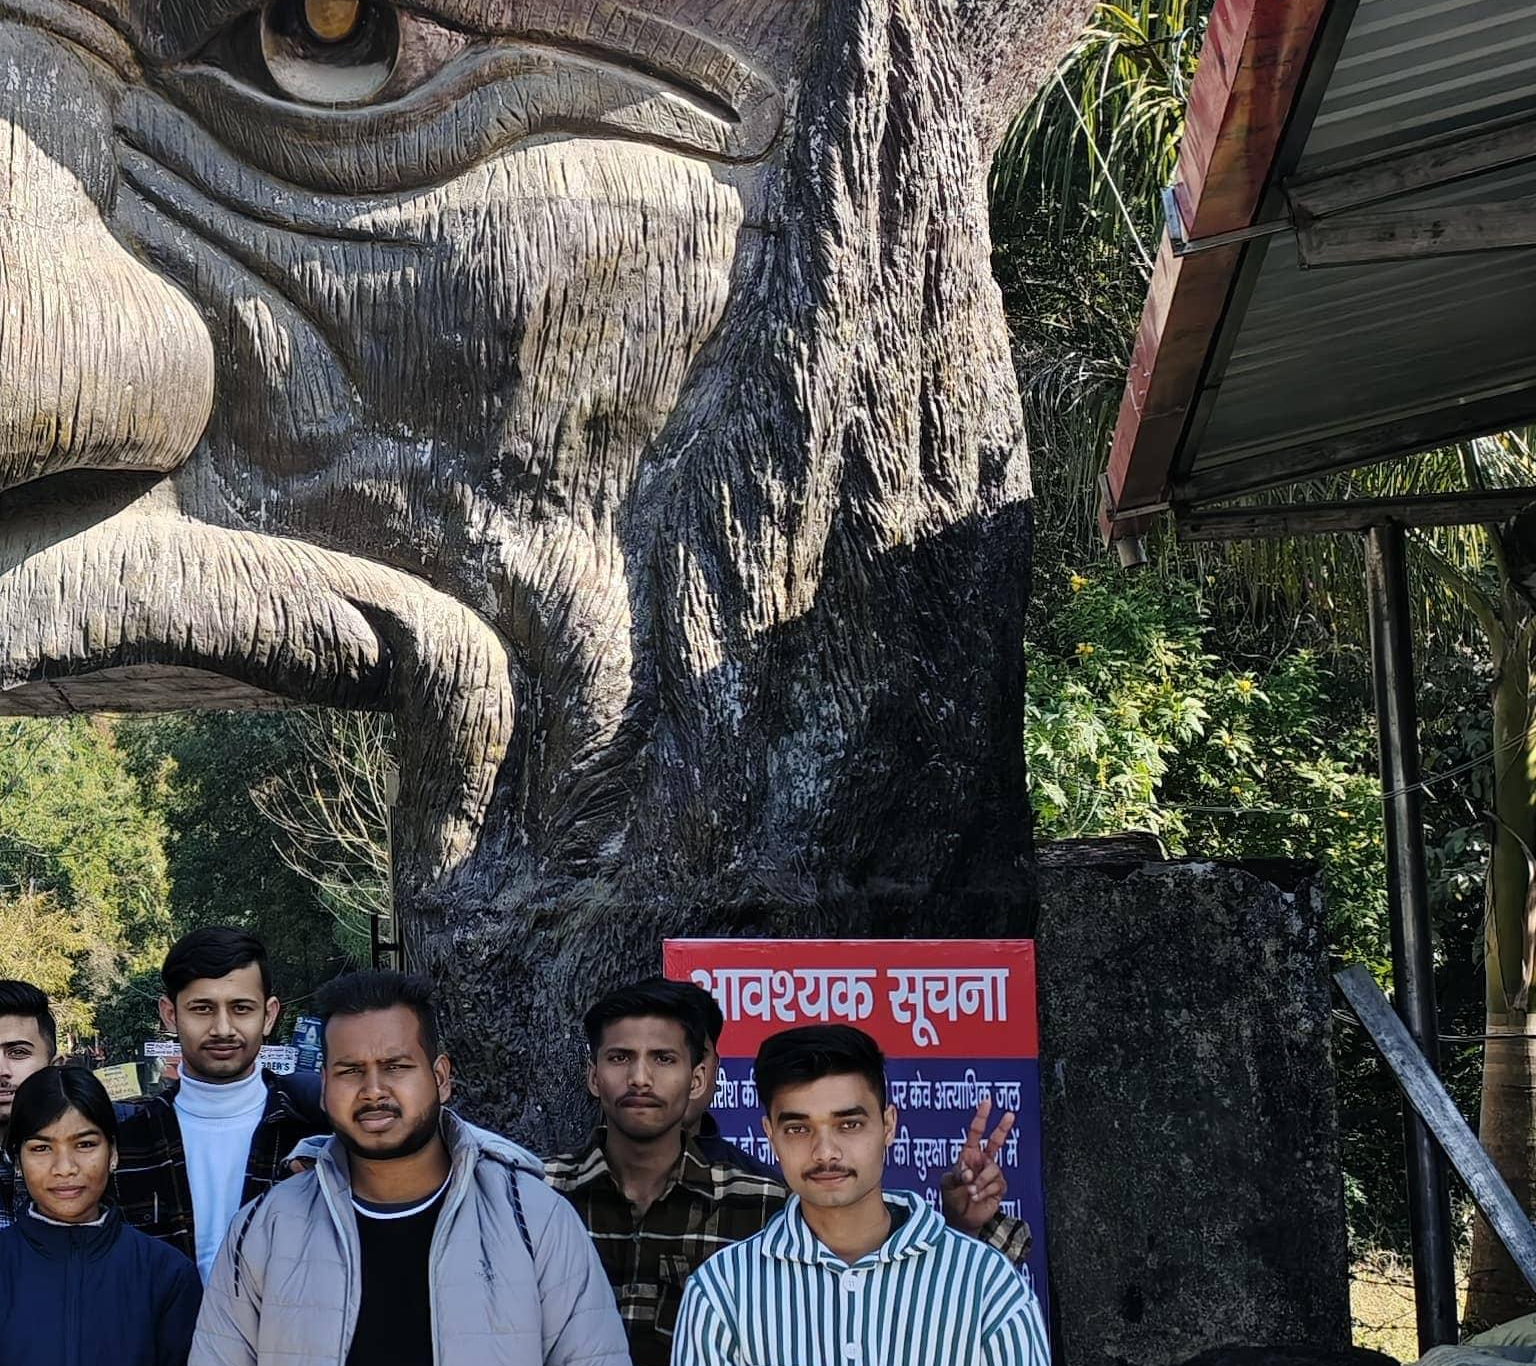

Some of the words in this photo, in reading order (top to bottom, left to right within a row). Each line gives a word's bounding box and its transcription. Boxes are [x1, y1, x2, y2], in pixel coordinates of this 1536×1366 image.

[690, 968, 876, 1022] आवश्यक
[886, 968, 1010, 1047] सूचना
[891, 1080, 908, 1110] पर
[994, 1081, 1021, 1111] जल
[892, 1125, 911, 1167] की
[913, 1138, 947, 1181] सुरक्षा
[1005, 1128, 1020, 1168] में
